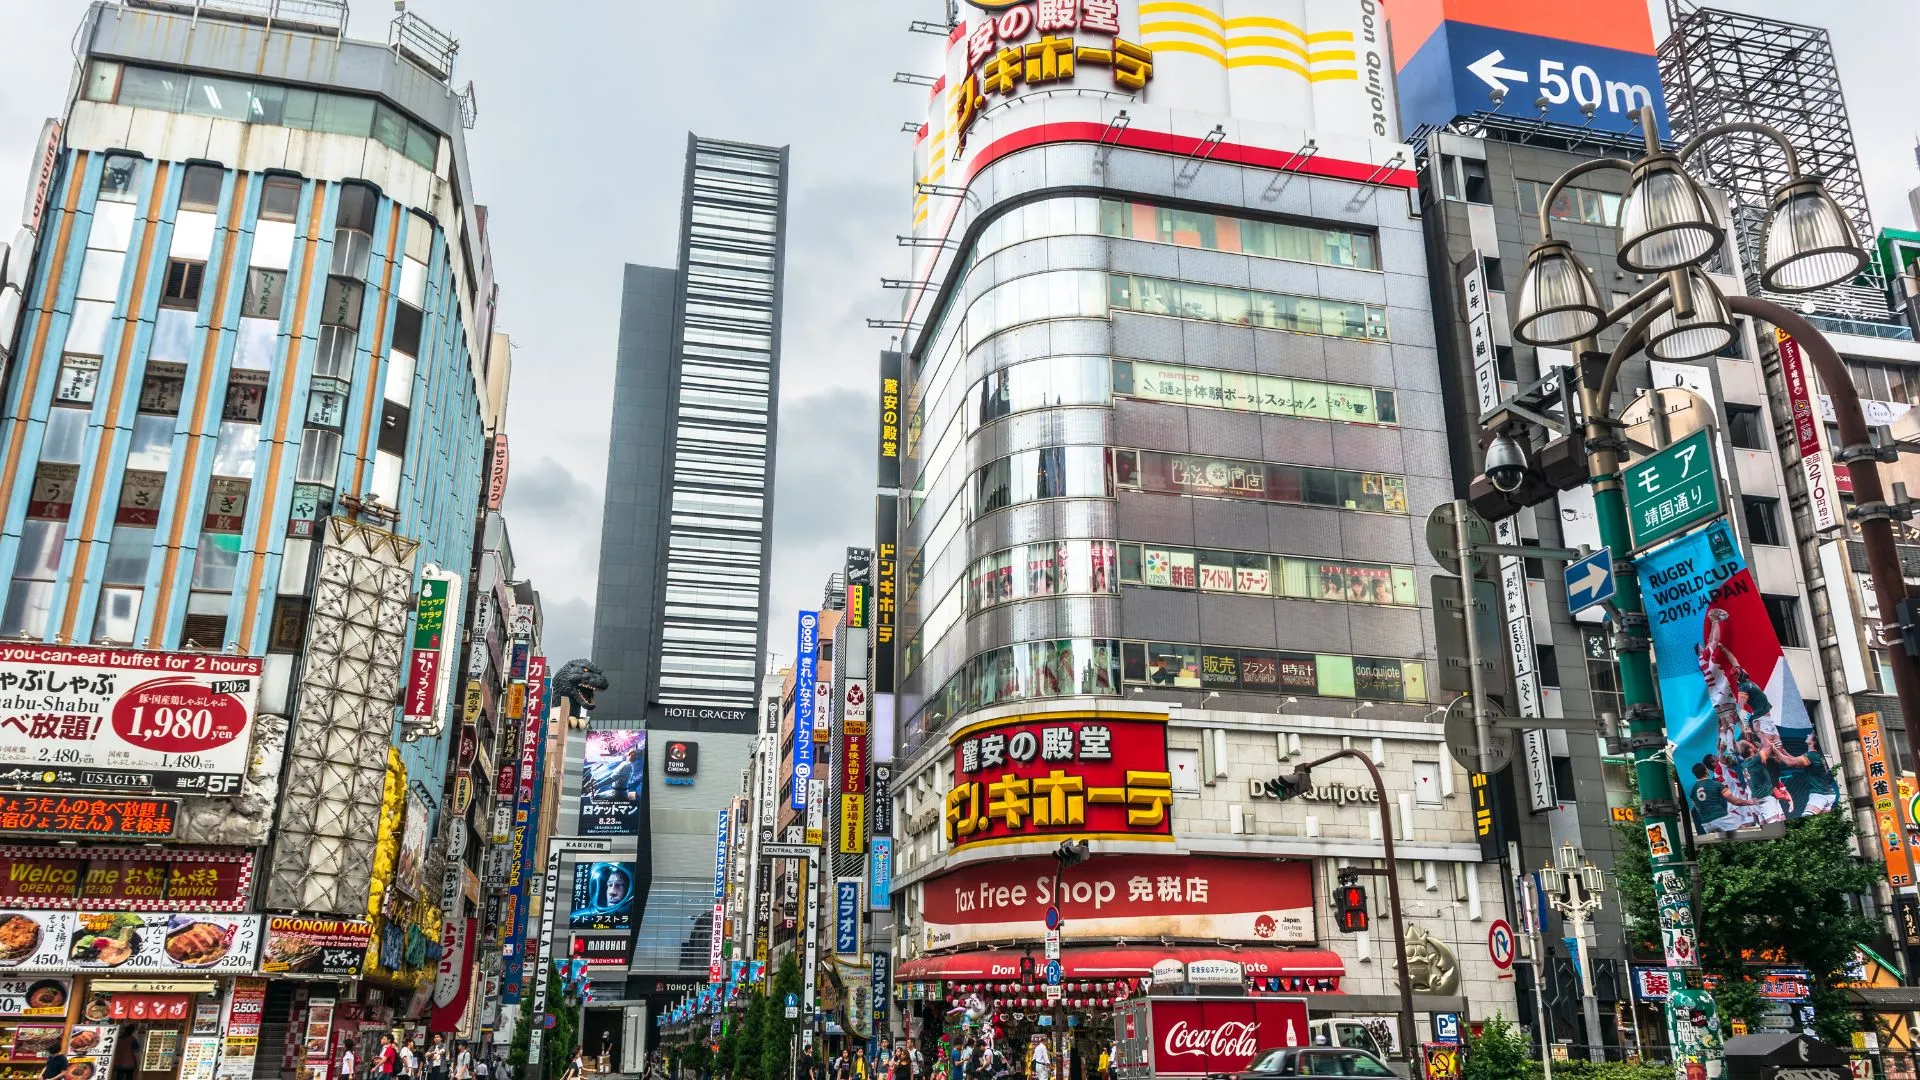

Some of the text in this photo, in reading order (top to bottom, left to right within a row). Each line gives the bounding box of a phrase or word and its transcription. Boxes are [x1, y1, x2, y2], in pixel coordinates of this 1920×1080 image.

[1368, 51, 1386, 137] Quijote
[1539, 59, 1652, 114] 50m
[1468, 279, 1491, 408] 6年 4組 ロック
[1159, 371, 1200, 382] namco
[882, 378, 897, 457] 驚安の殿堂
[1638, 445, 1697, 493] モア
[1644, 485, 1703, 528] 靖国通り
[1172, 565, 1195, 587] 新宿
[1202, 568, 1232, 589] アイドル
[1238, 571, 1268, 592] ステージ
[1648, 558, 1695, 589] RUGBY
[1506, 578, 1517, 614] おかか
[1698, 579, 1749, 611] JAPAN
[1512, 624, 1524, 673] ESOLA
[110, 652, 160, 668] buffet
[165, 656, 189, 670] for
[194, 658, 205, 670] 2
[210, 657, 258, 673] hours
[1203, 656, 1236, 674] 販売
[1242, 663, 1276, 674] ブランド
[1282, 665, 1315, 676] 時計
[1355, 664, 1400, 679] don.quijote
[214, 681, 247, 694] 120分
[415, 658, 433, 714] ひょうたん
[664, 708, 746, 720] HOTEL GRACERY
[798, 657, 813, 760] きれいなネットカフェ
[846, 709, 866, 717] 鳥メロ
[127, 706, 232, 742] 1,980 yen
[962, 726, 1112, 774] 驚安の殿堂
[1864, 736, 1874, 761] セット
[1870, 730, 1880, 756] フリー
[38, 748, 94, 764] 2,480 yen
[160, 754, 201, 768] 1,480
[848, 744, 860, 792] 豊後高田どり
[1528, 733, 1544, 808] ミステリアス
[1870, 761, 1890, 797] 麻雀
[208, 776, 240, 793] 5F
[1306, 782, 1380, 805] Quijote
[1697, 787, 1706, 801] 6
[846, 804, 859, 820] 酒場
[121, 818, 171, 833] を検索
[716, 840, 726, 895] カラオケランド
[19, 884, 52, 893] OPEN
[1892, 876, 1908, 884] 3F
[540, 864, 558, 948] GODZILLA
[956, 876, 1209, 914] Tax Free Shop 免税店
[46, 914, 56, 933] そば
[272, 918, 372, 934] OKONOMI YAKI
[840, 885, 855, 950] カラオケ
[239, 916, 256, 954] かつ丼
[588, 940, 626, 950] MARUHAN
[712, 913, 723, 967] 新宿東宝ビル店
[806, 882, 818, 990] ゴジラロード
[940, 932, 951, 942] Quijote
[440, 922, 456, 974] トラノコ
[32, 953, 64, 966] 450円
[127, 956, 158, 967] 500円
[222, 956, 252, 967] 520円
[992, 965, 1016, 976] Don
[536, 957, 549, 998] ROAD
[874, 954, 886, 1009] カラオケ
[1049, 966, 1054, 980] P
[1645, 970, 1669, 996] 薬
[115, 1001, 187, 1019] とらそば
[873, 1010, 885, 1020] B1
[1438, 1018, 1448, 1034] P
